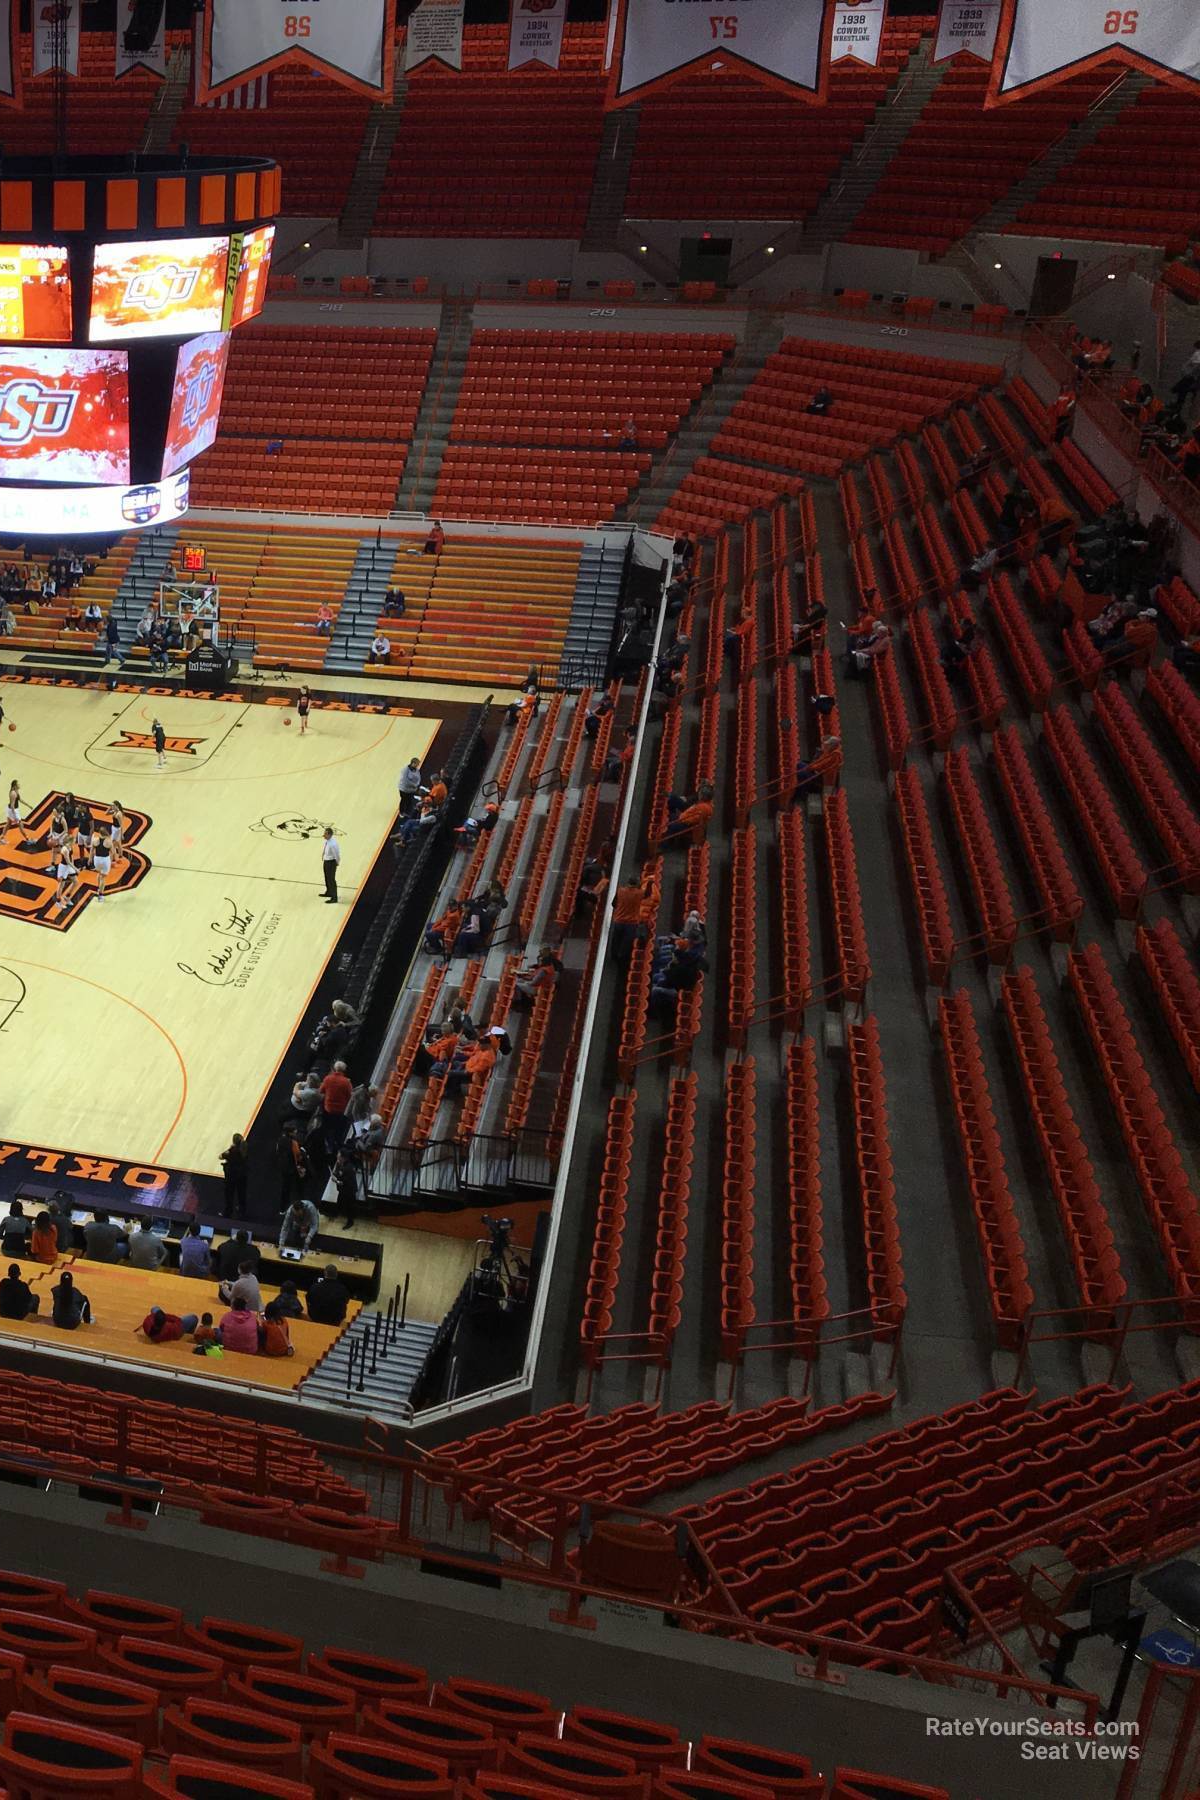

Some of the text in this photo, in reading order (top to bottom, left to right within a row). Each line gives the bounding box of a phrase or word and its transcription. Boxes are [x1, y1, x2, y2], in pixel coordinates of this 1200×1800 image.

[957, 9, 983, 19] 1939
[842, 15, 866, 25] 1938
[836, 27, 868, 35] COWBOY
[952, 22, 984, 30] COWBOY
[949, 29, 987, 37] WRESTLING
[226, 238, 242, 296] Hertz
[122, 264, 200, 311] OSU
[590, 308, 616, 316] 219
[881, 326, 908, 336] 220
[187, 555, 203, 570] 30
[234, 911, 283, 988] EDDIE SUTTON COURT
